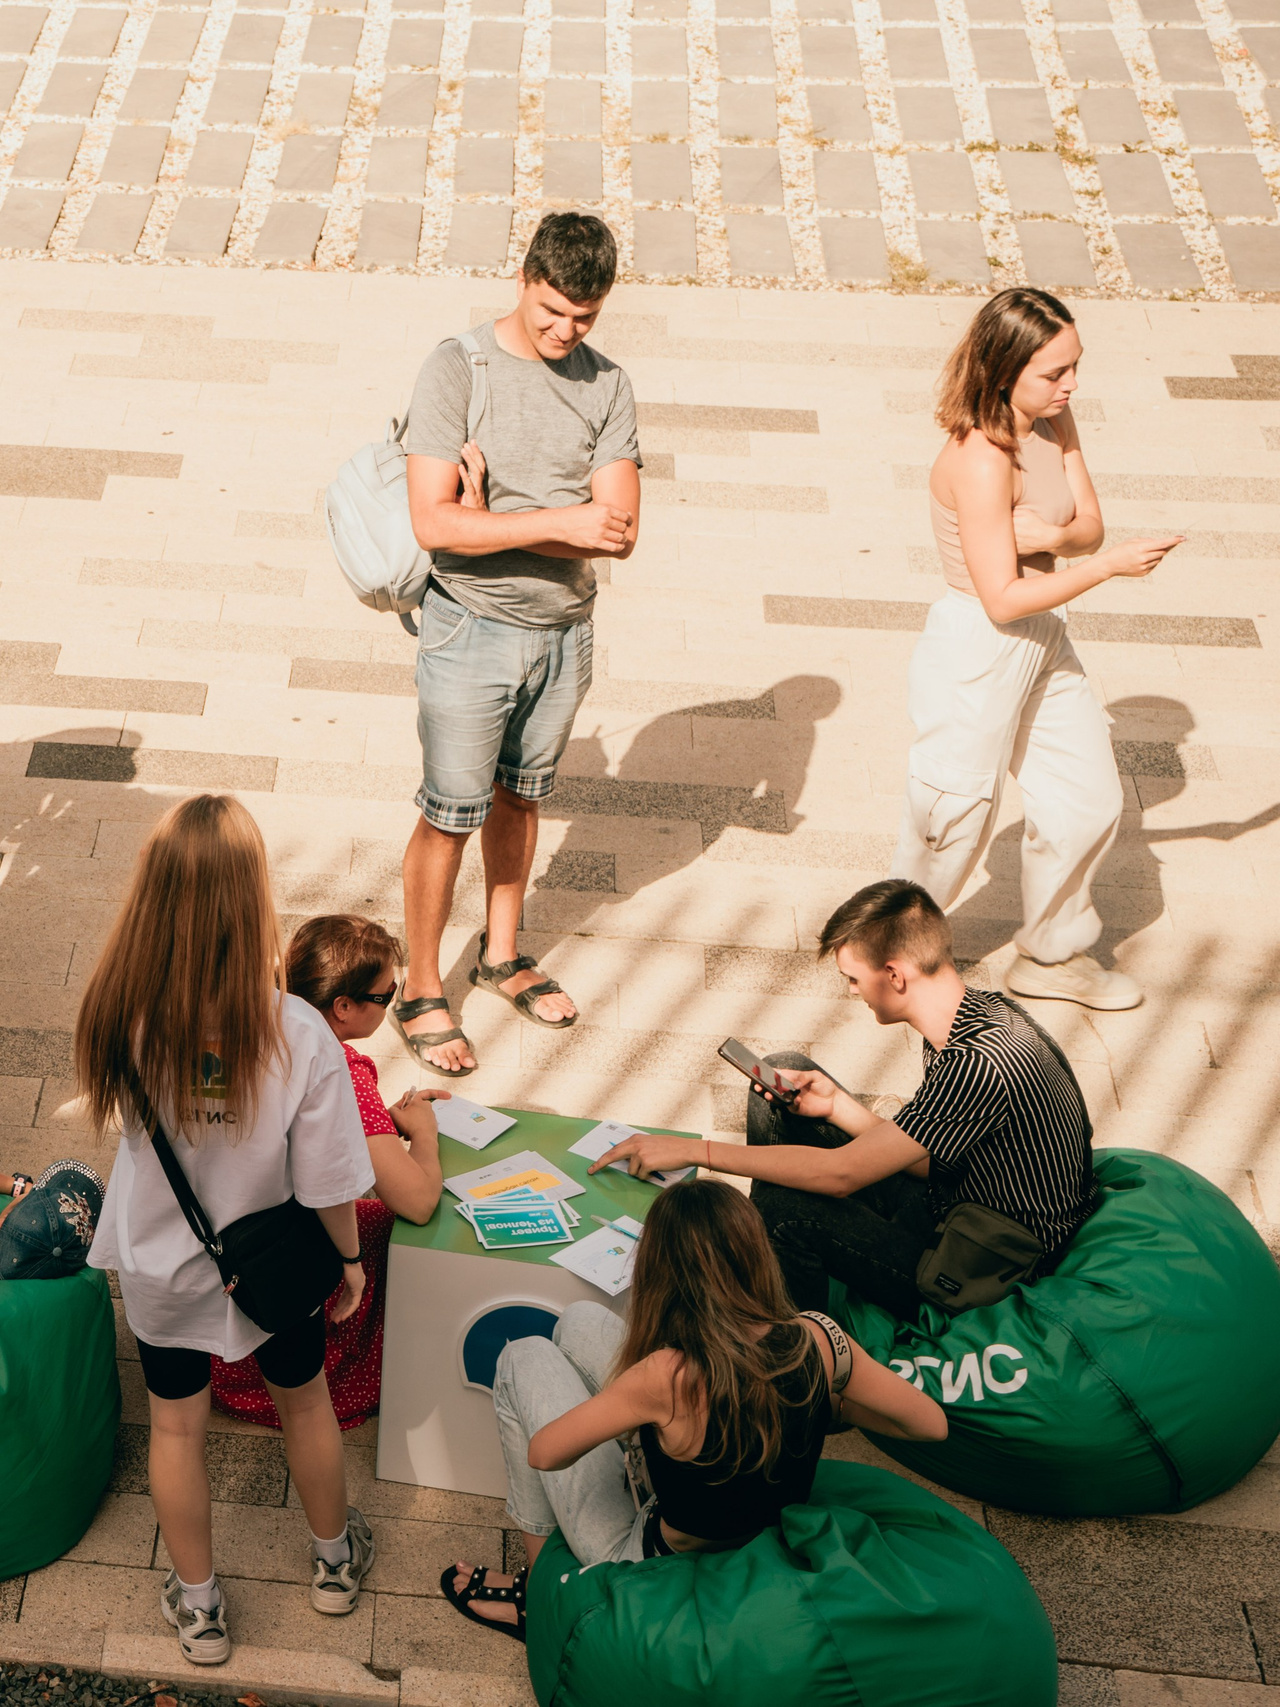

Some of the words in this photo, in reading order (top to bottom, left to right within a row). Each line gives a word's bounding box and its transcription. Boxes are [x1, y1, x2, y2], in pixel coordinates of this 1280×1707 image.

[484, 1220, 537, 1231] Челнов!
[537, 1218, 555, 1226] из
[511, 1224, 559, 1236] Привет
[807, 1311, 847, 1356] GUESS
